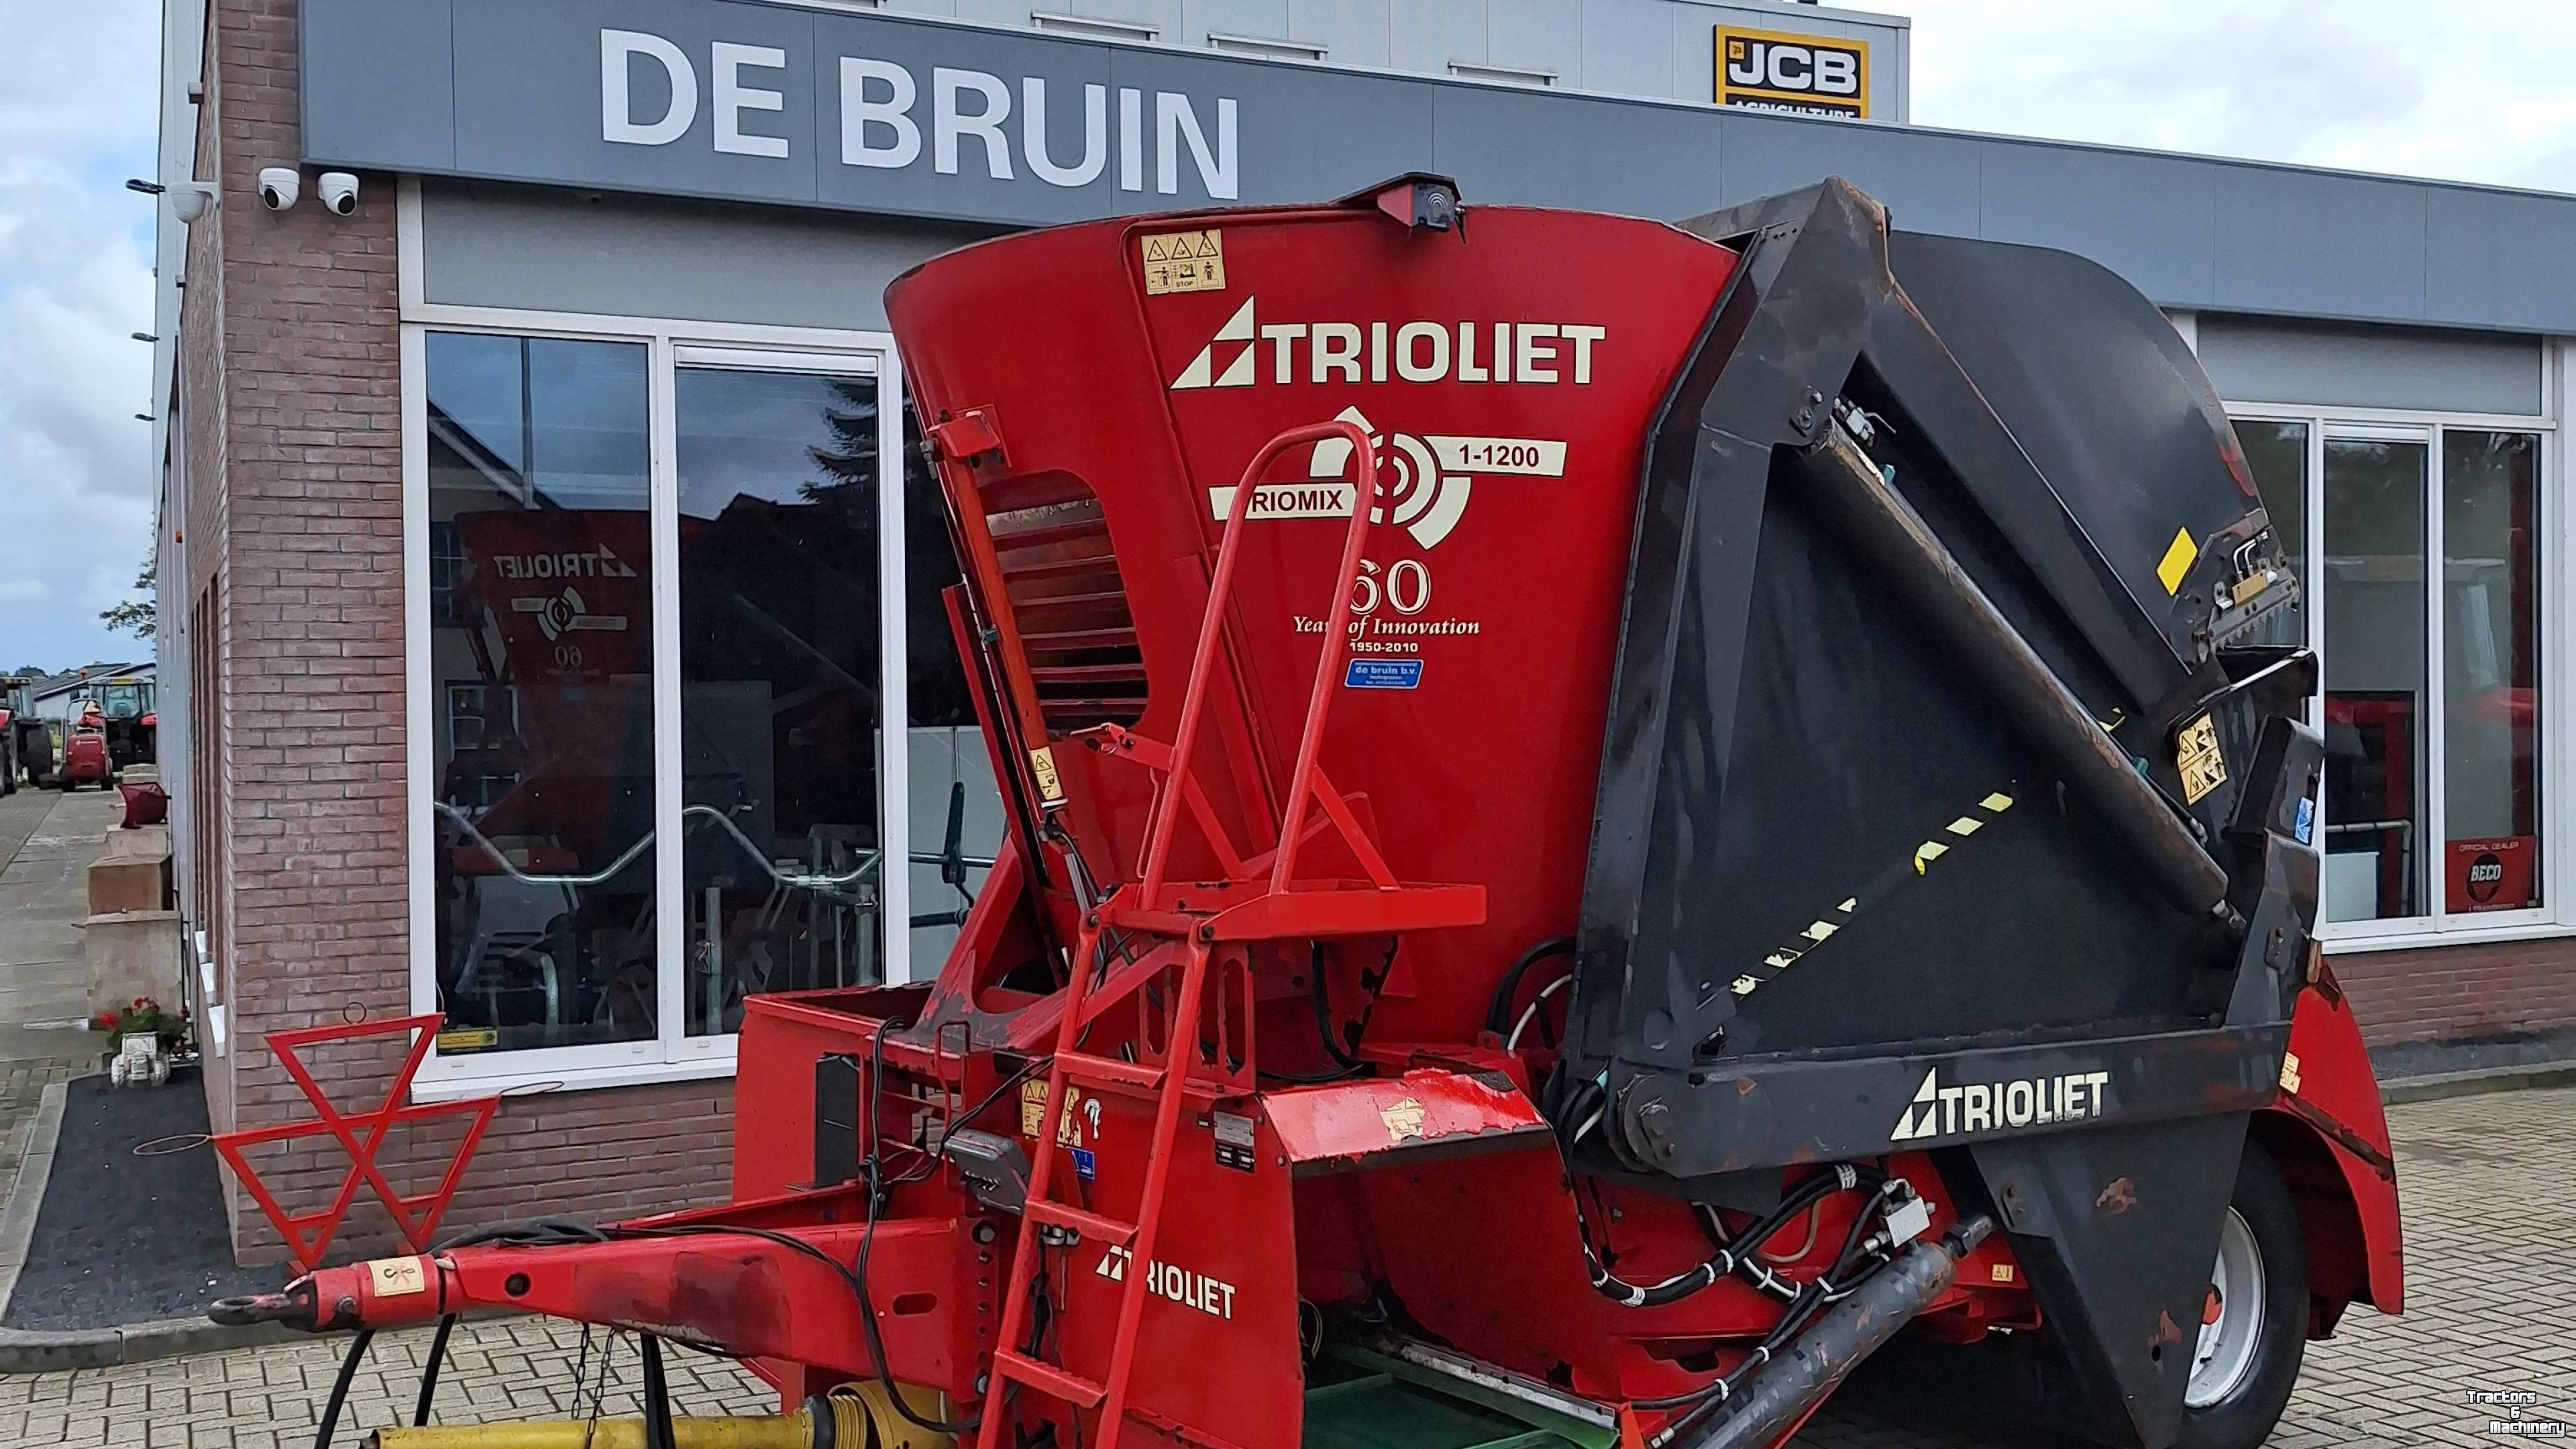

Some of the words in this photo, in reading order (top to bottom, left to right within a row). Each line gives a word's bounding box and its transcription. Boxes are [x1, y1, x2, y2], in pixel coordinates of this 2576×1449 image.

[1729, 43, 1857, 94] JCB
[600, 29, 789, 158] DE
[839, 56, 1238, 201] BRUIN
[1260, 321, 1607, 385] TRIOLIET
[1459, 444, 1540, 467] 1-1200
[1252, 490, 1343, 512] RIOMIX
[1350, 559, 1432, 615] 60
[1348, 615, 1371, 641] of
[1374, 617, 1480, 635] Innovation
[1349, 642, 1418, 652] 1950-2010
[1355, 666, 1368, 674] de
[1371, 666, 1398, 675] bruin
[1401, 667, 1417, 675] b.v.
[2470, 864, 2502, 882] BECO
[1938, 1071, 2109, 1135] TRIOLIET
